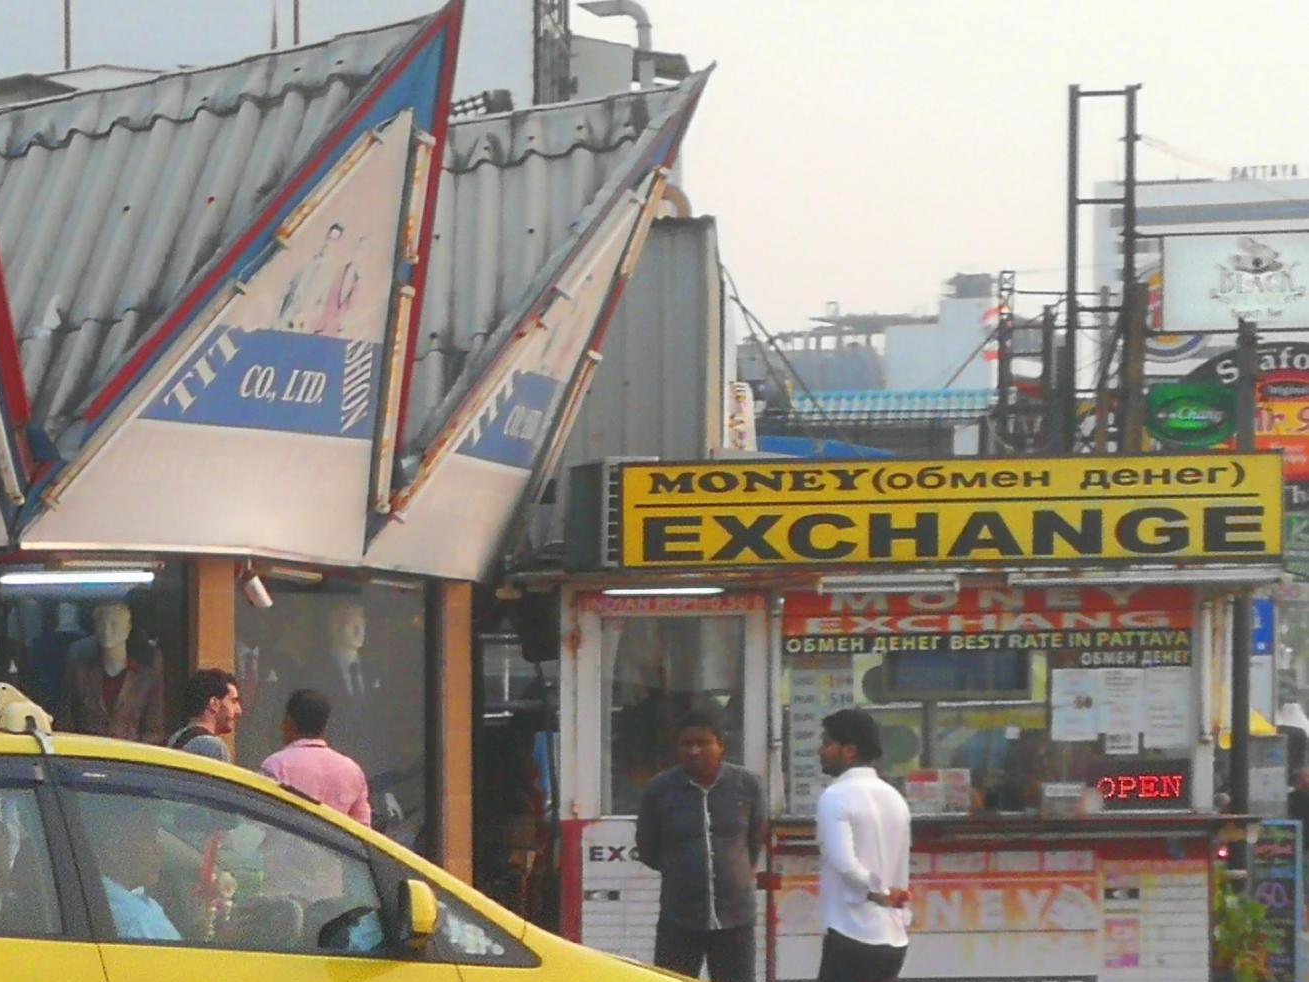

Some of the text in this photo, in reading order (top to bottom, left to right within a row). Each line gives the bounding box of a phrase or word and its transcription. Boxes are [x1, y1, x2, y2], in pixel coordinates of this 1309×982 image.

[281, 368, 328, 405] LTD.
[1080, 462, 1246, 489] денег)
[643, 505, 1266, 562] EXCHANGE
[786, 630, 1189, 655] ОБМЕН ДЕНЕГ BEST RATE IN PATTAYA
[1080, 651, 1137, 666] ОБМЕН
[1097, 775, 1183, 799] OPEN
